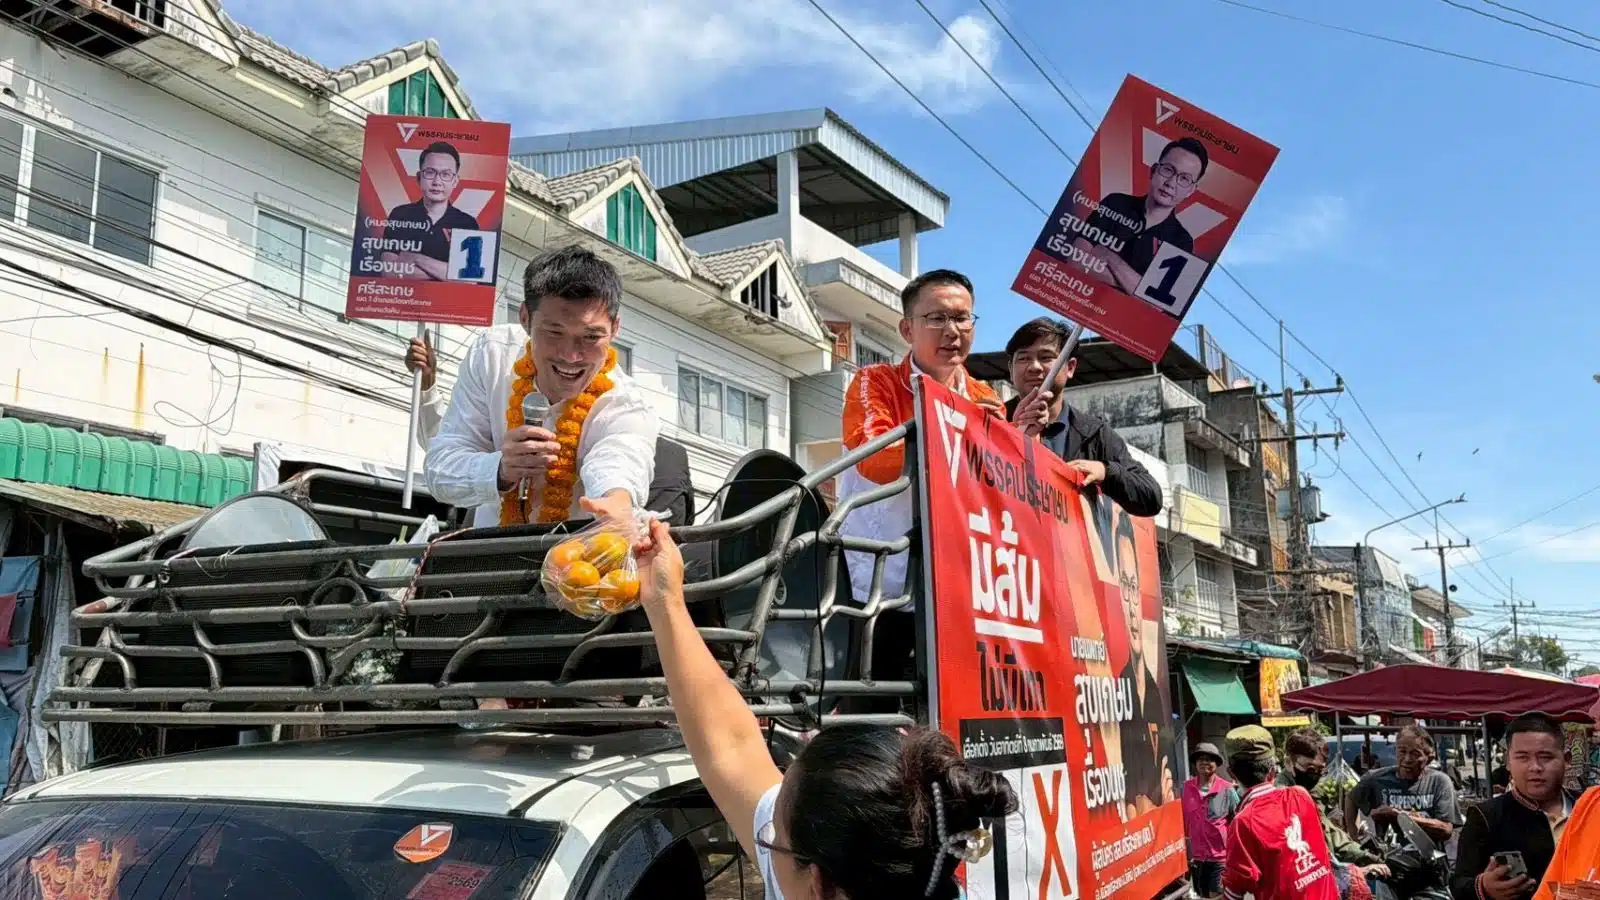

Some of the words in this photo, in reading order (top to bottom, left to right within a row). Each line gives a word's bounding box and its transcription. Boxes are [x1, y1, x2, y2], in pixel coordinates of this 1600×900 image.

[418, 129, 480, 142] พรรคประชาชน
[1173, 115, 1240, 155] พรรคประชาชน
[364, 215, 431, 233] (หมอสุขเกษม)
[1058, 210, 1126, 254] สุขเกษม
[1071, 188, 1145, 235] (หมอสุขเกษม)
[361, 236, 423, 254] สุขเกษม
[458, 235, 485, 280] 1
[1046, 232, 1108, 275] เรืองนุช
[359, 256, 416, 278] เรืองนุช
[1033, 259, 1095, 298] ศรีสะเกษ
[1144, 254, 1189, 307] 1
[358, 280, 414, 297] ศรีสะเกษ
[966, 441, 1069, 524] พรรคประชาชน
[968, 507, 1041, 623] มีส้ม
[1074, 673, 1134, 748] สุขเกษม
[448, 875, 480, 889] 2569
